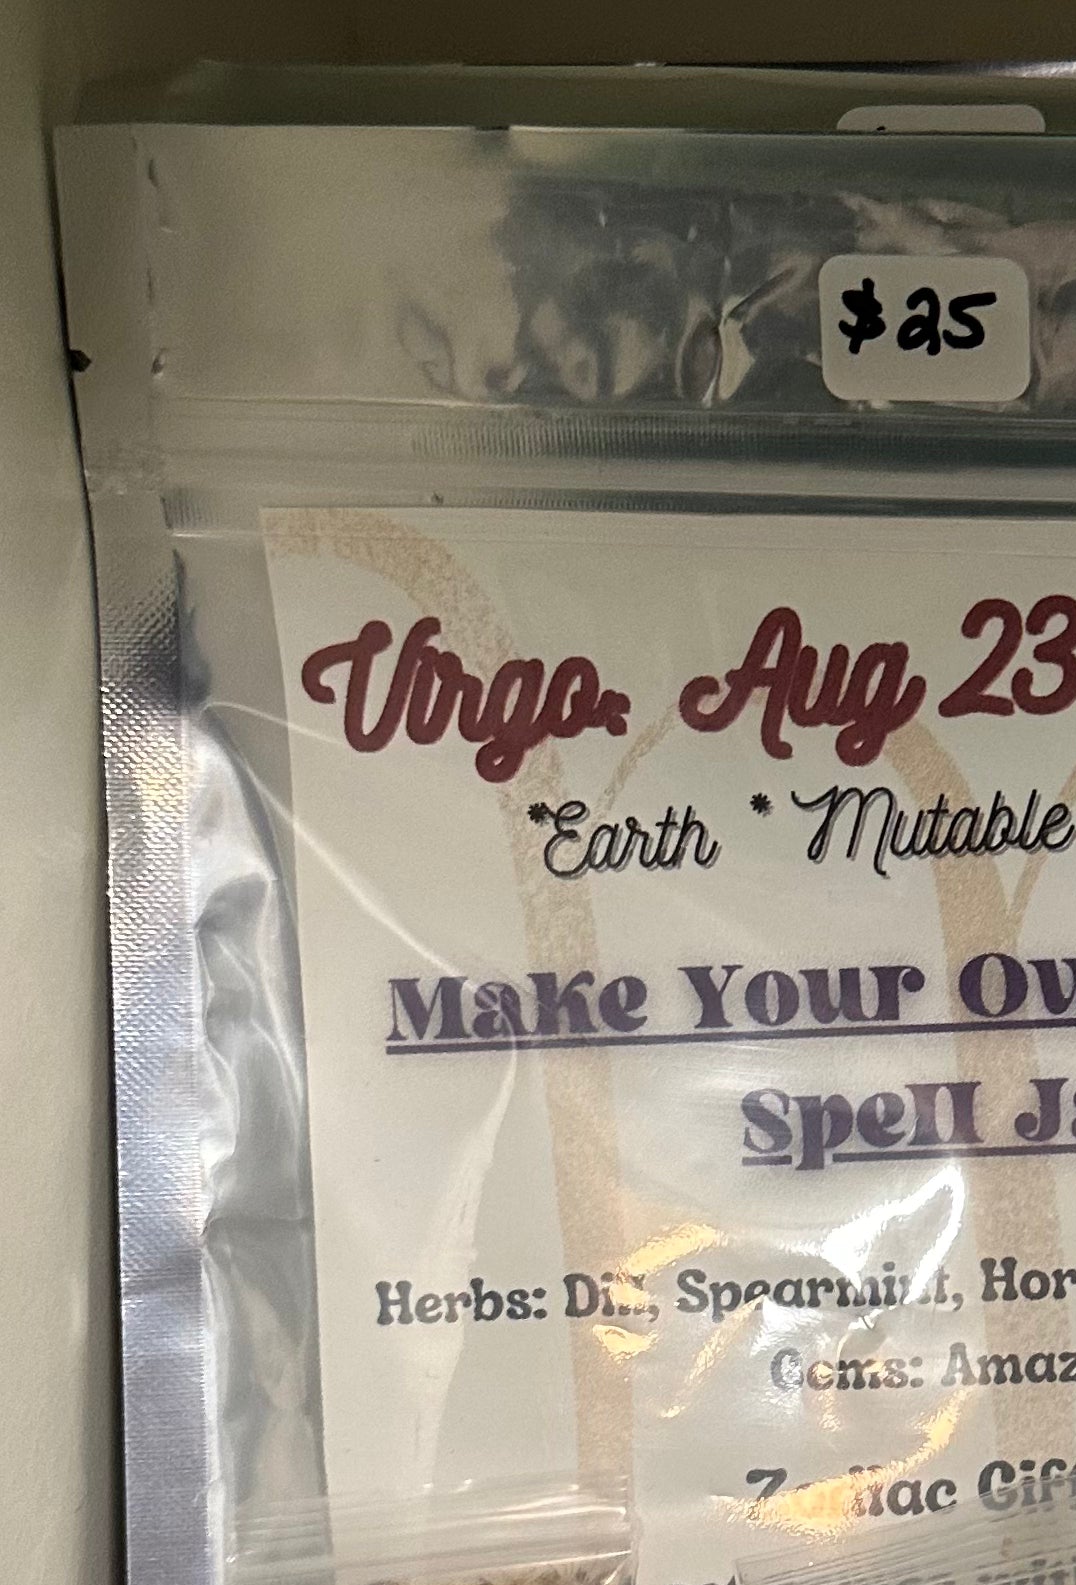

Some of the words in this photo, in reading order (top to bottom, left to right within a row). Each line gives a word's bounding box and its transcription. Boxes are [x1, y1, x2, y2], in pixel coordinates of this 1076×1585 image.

[839, 278, 996, 356] $25
[679, 607, 926, 767] Aug
[386, 971, 648, 1041] Make
[678, 963, 925, 1028] Your
[742, 1080, 982, 1170] Spell
[375, 1279, 548, 1325] Herbs:
[770, 1348, 924, 1391] Gems:
[746, 1458, 957, 1518] Ziac
